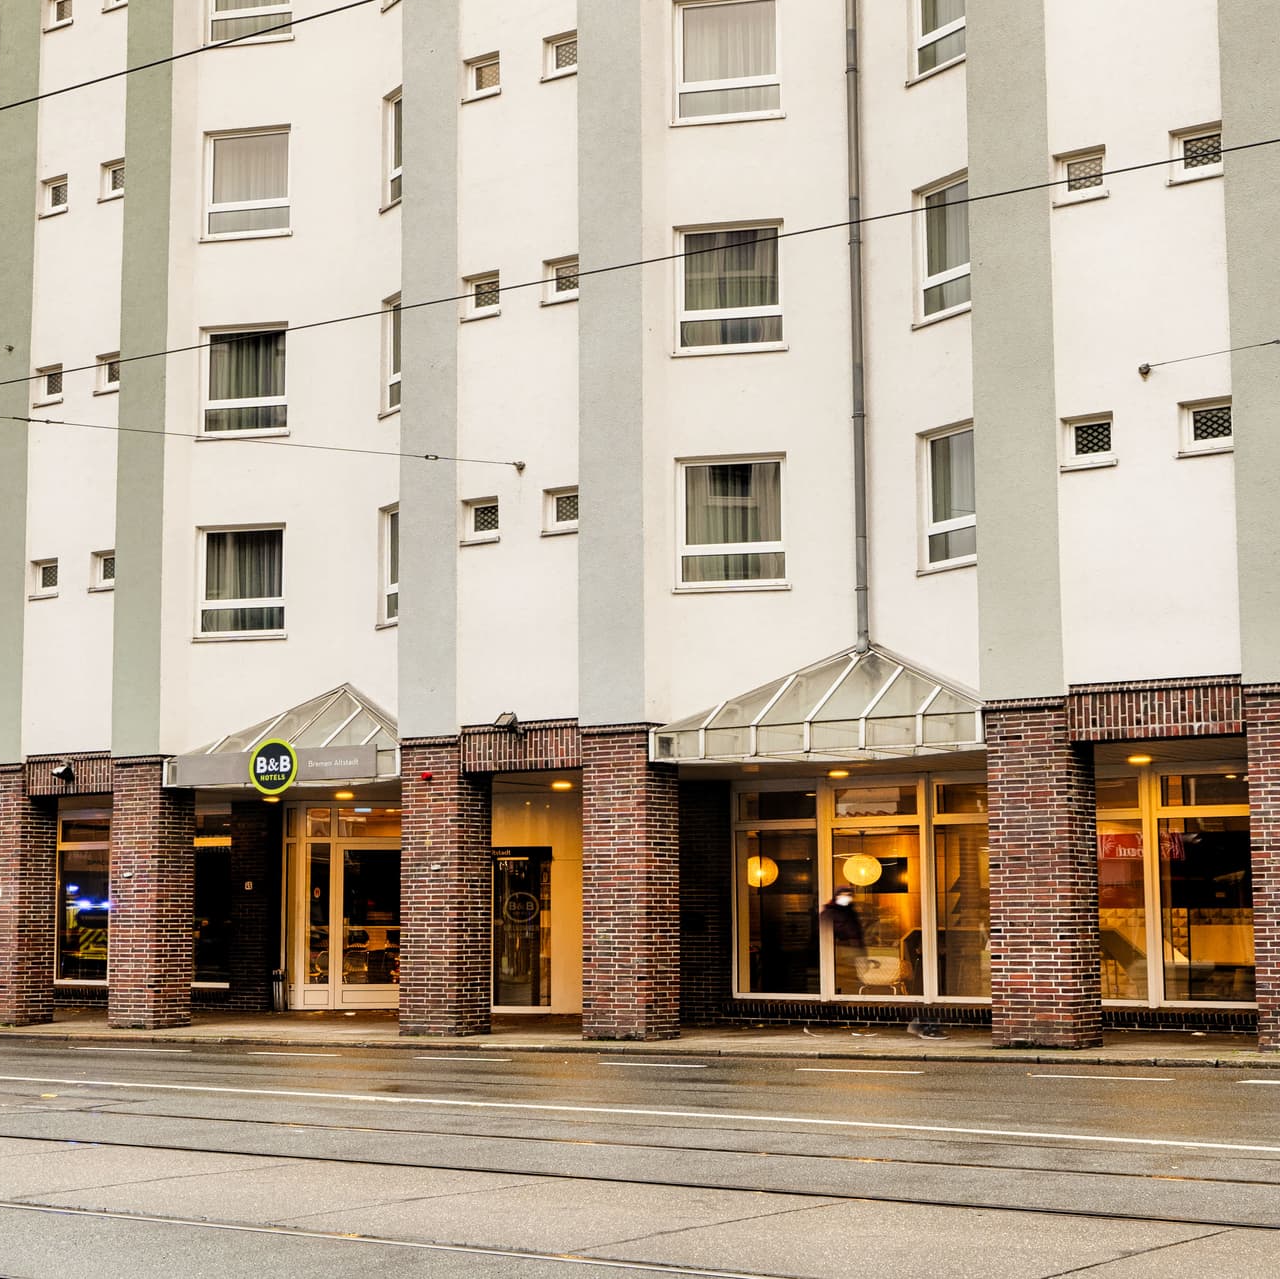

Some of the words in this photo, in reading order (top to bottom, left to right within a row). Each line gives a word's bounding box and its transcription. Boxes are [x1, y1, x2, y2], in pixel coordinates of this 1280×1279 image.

[256, 755, 291, 773] B&B
[307, 760, 332, 768] Bremen
[334, 759, 359, 767] Altstadt
[260, 773, 286, 781] HOTELS
